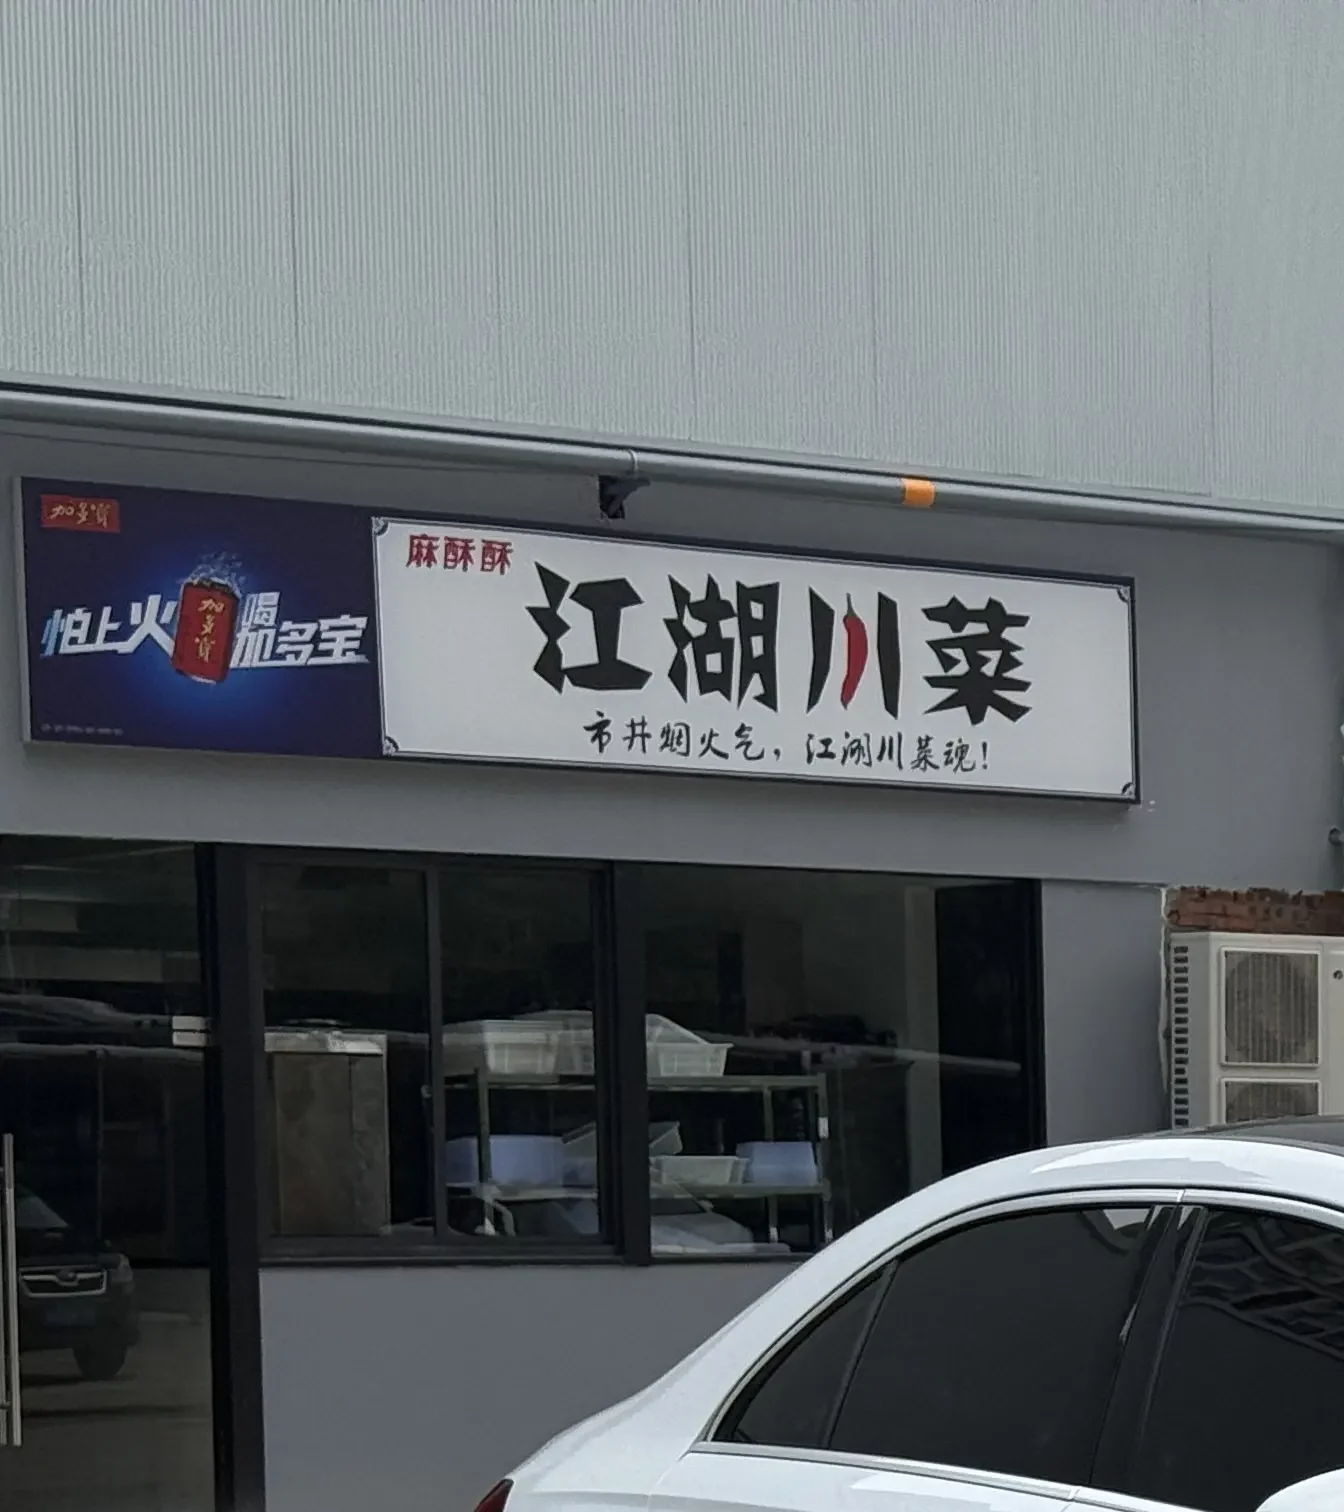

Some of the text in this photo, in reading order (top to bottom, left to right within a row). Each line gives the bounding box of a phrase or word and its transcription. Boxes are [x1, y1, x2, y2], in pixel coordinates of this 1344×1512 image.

[405, 533, 513, 575] 麻酥酥
[526, 562, 1032, 724] 江湖川菜
